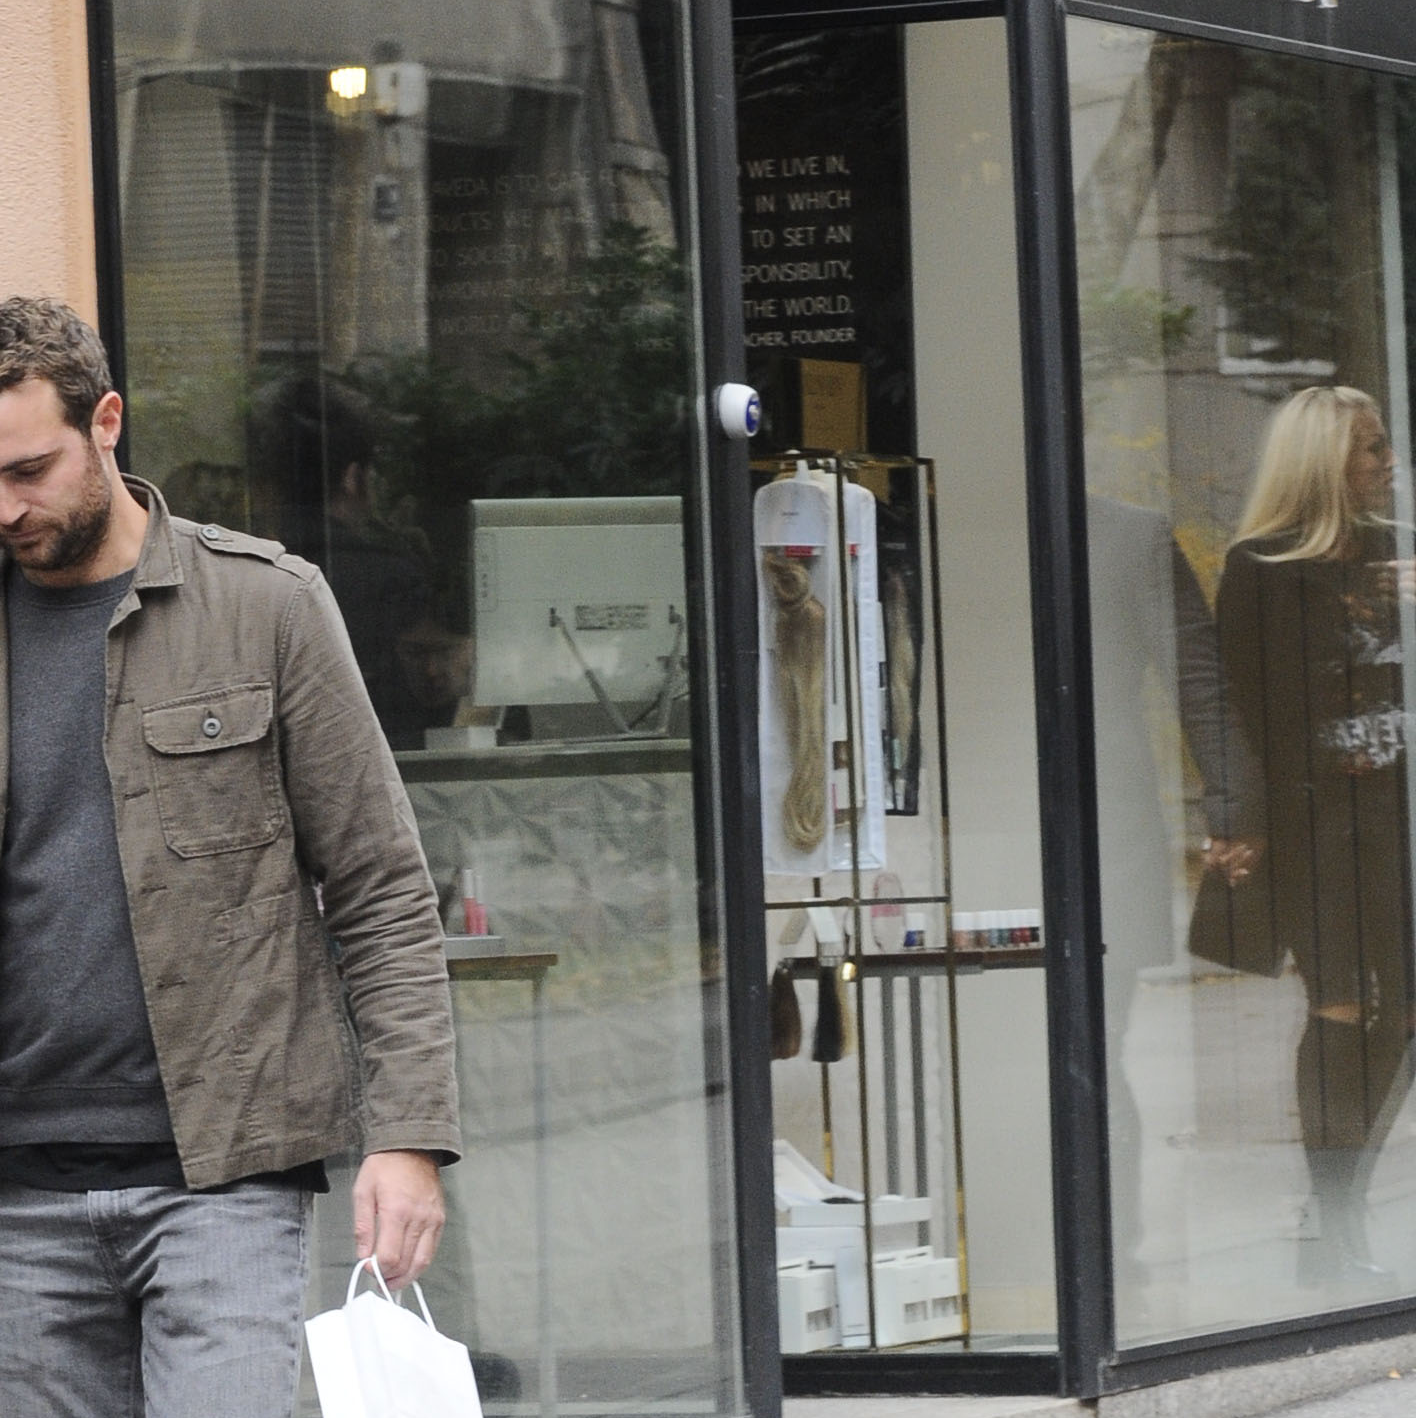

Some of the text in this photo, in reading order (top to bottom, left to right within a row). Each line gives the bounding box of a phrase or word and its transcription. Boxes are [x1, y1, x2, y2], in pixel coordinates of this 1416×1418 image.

[746, 159, 776, 178] WE
[782, 156, 820, 177] LIVE
[755, 190, 851, 213] IN WHICH
[750, 224, 852, 249] TO SET AN
[791, 327, 856, 344] FOUNDER
